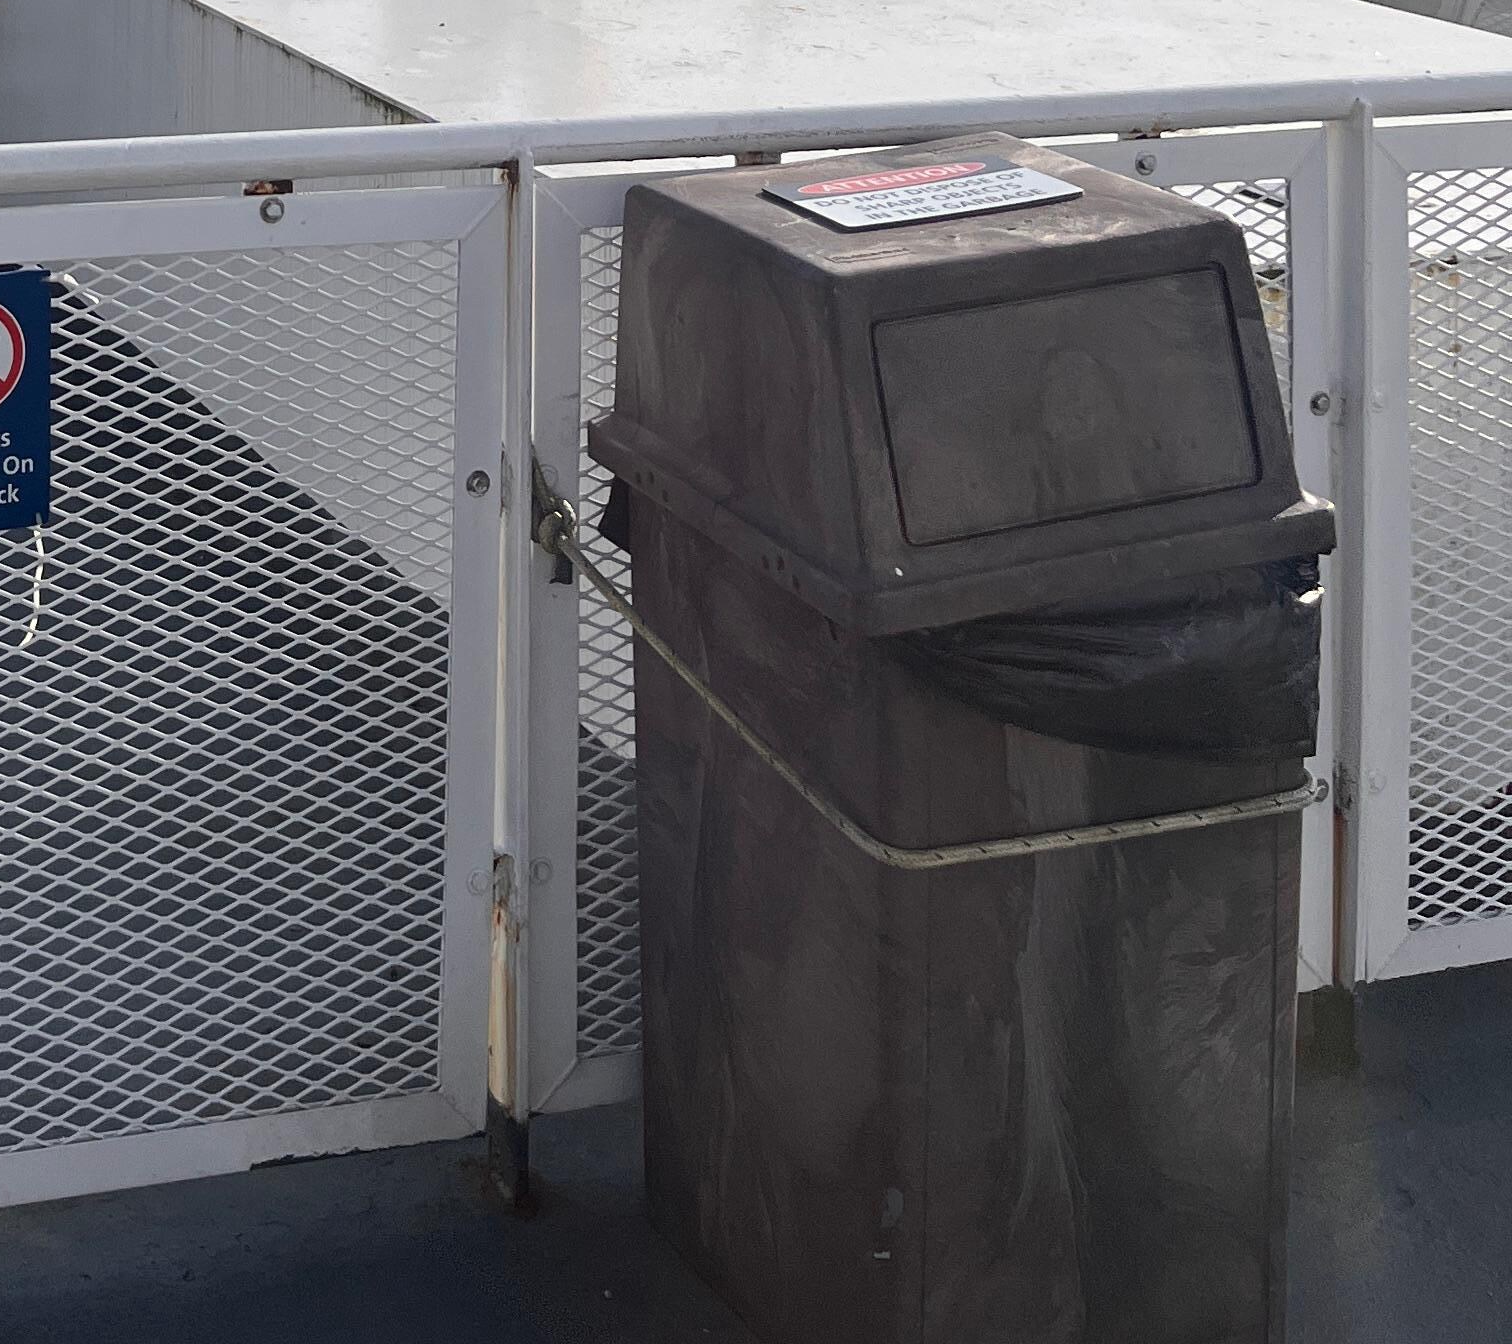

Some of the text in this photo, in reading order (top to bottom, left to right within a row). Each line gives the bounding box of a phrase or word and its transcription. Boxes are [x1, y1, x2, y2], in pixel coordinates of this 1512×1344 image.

[814, 171, 1025, 207] DO NOT DISPOSE OF
[822, 164, 970, 192] ATTENTION
[855, 182, 1022, 212] SHARP OBJECTS
[865, 188, 1046, 220] IN THE GARBAGE
[2, 455, 34, 475] On
